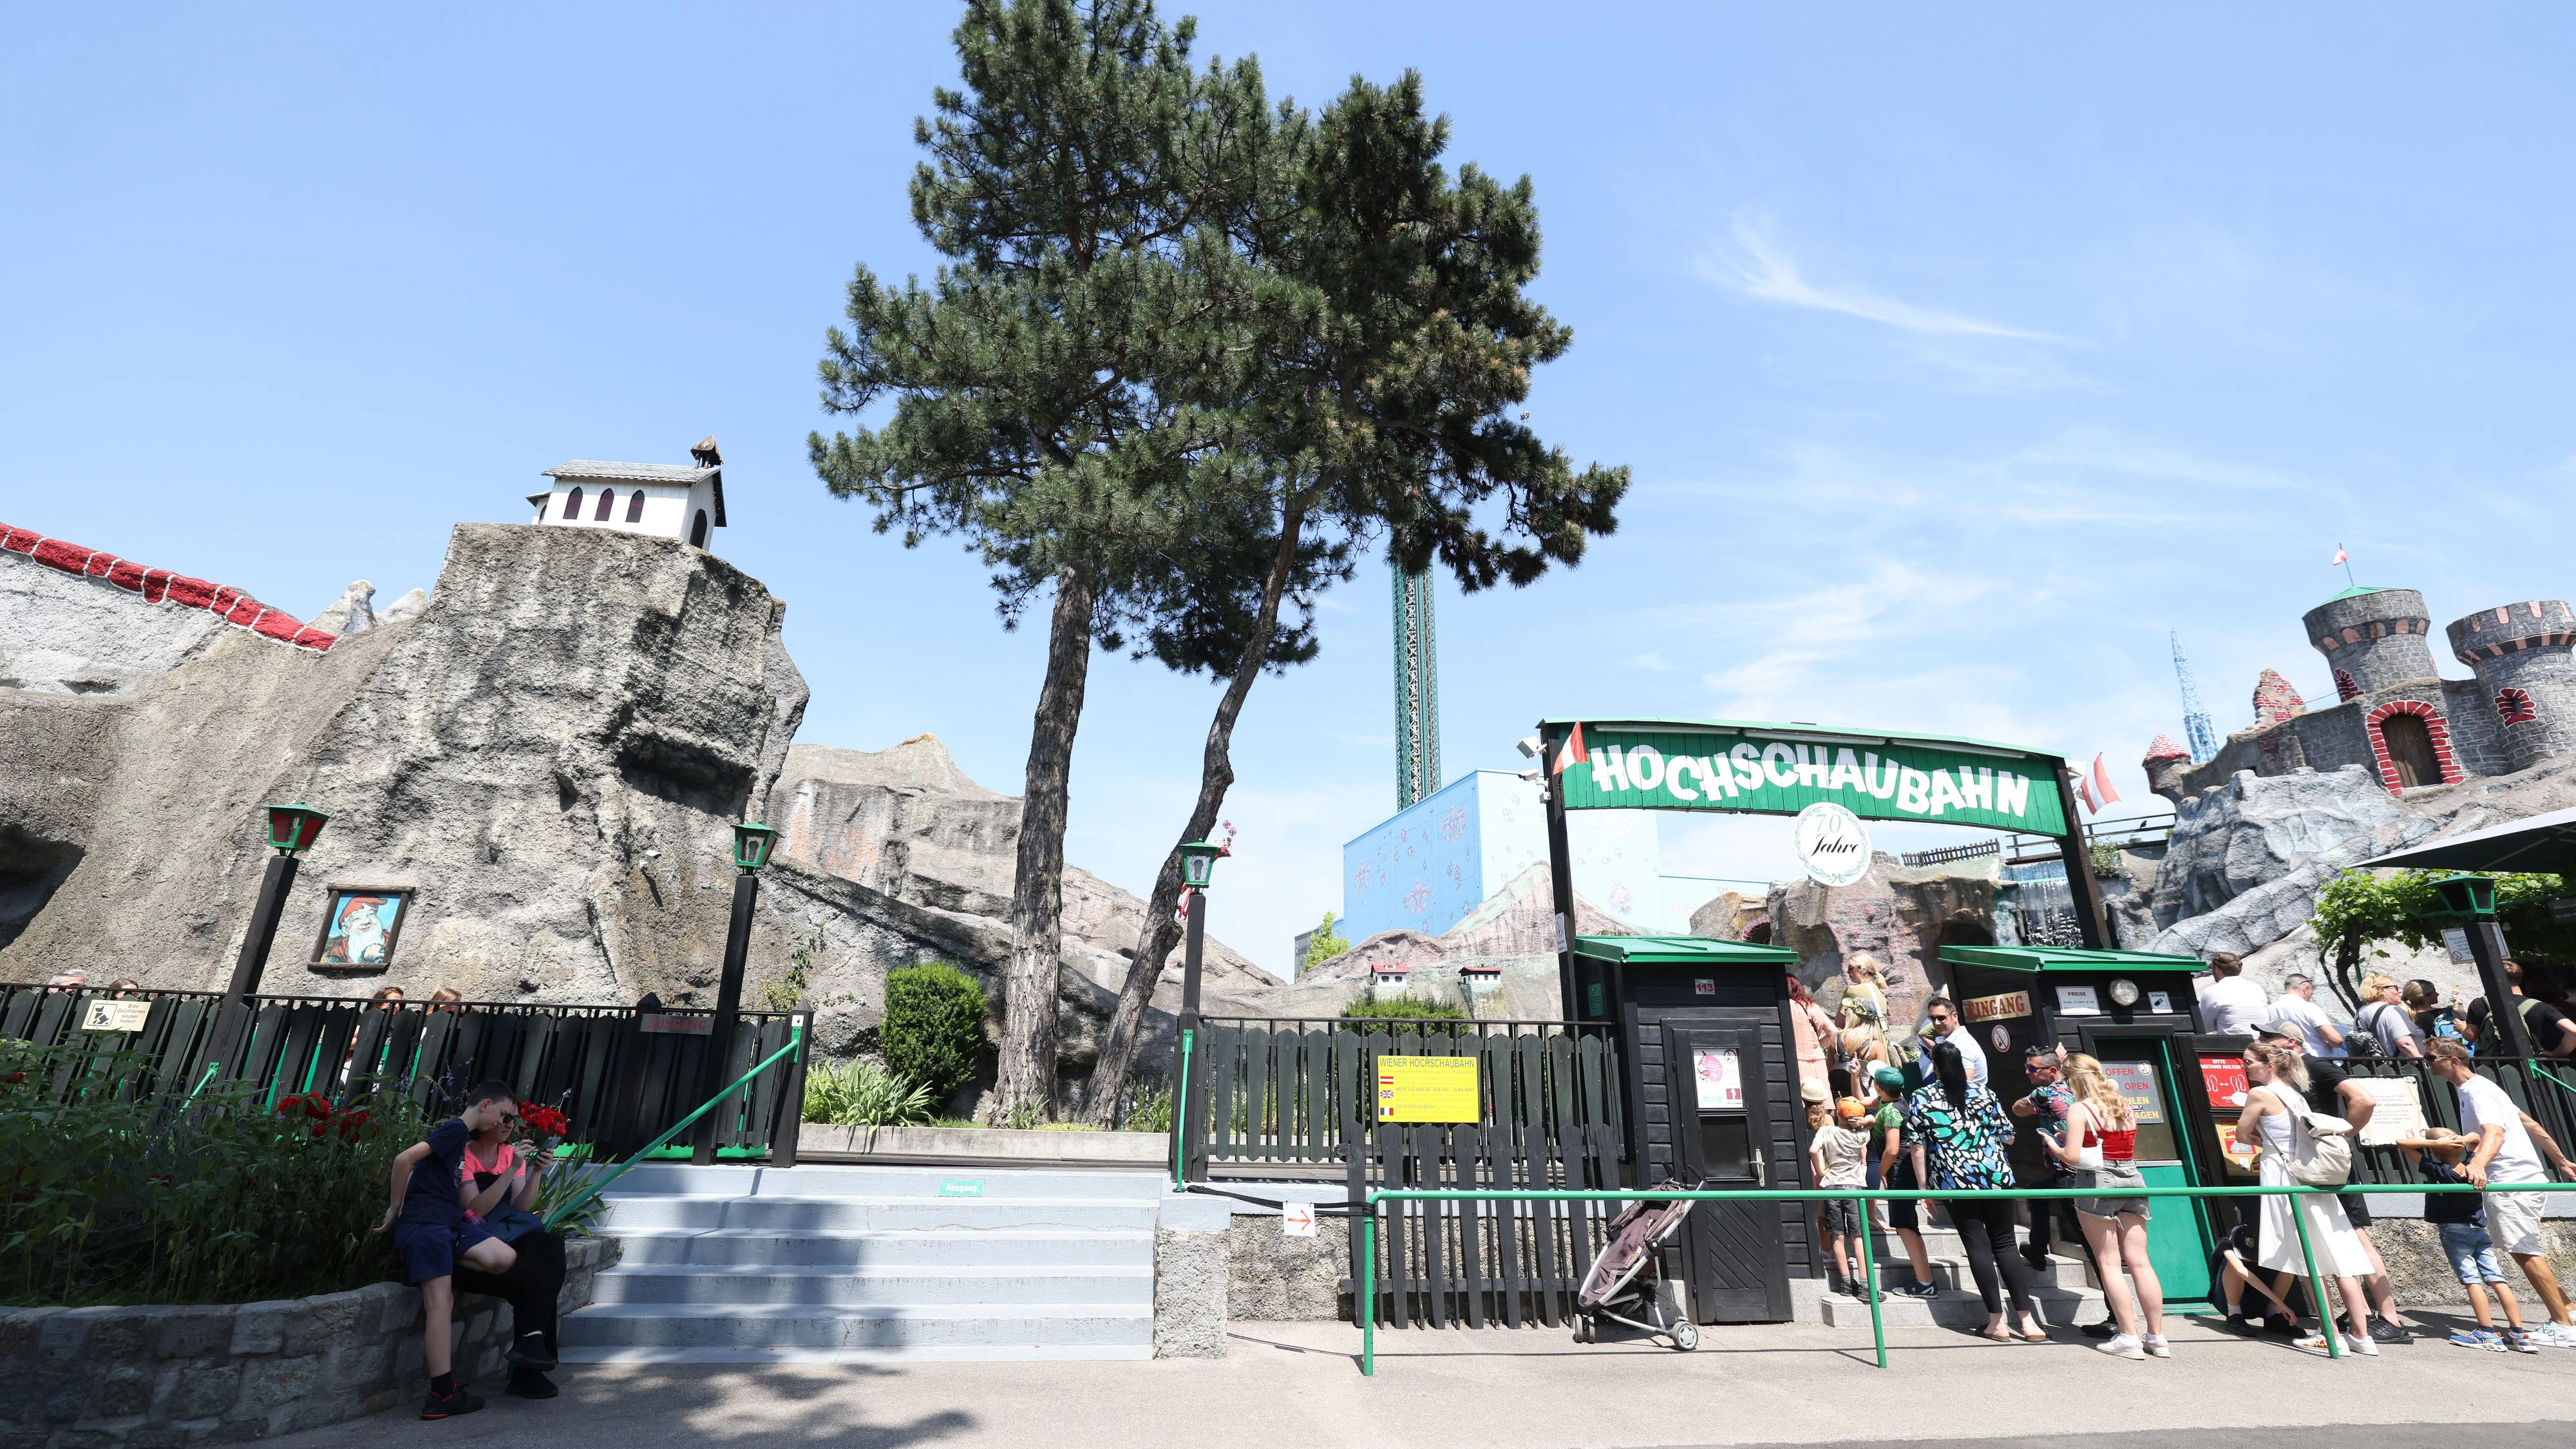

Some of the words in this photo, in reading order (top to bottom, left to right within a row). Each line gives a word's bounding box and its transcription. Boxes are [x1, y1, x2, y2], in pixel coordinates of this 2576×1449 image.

[1590, 742, 2030, 817] HOCHSCHAUBAHN
[1816, 814, 1841, 833] 70
[1807, 833, 1860, 857] Jahre
[1696, 983, 1714, 992] 113
[1967, 995, 2025, 1019] EINGANG
[647, 1017, 707, 1032] AUSGANG
[1380, 1057, 1407, 1067] WIENER
[1409, 1058, 1474, 1068] HOCHSCHAUBAHN
[2105, 1068, 2134, 1076] OFFEN
[2125, 1082, 2149, 1090] OPEN
[2135, 1111, 2159, 1119] AGEN
[945, 1183, 977, 1193] Ausgang
